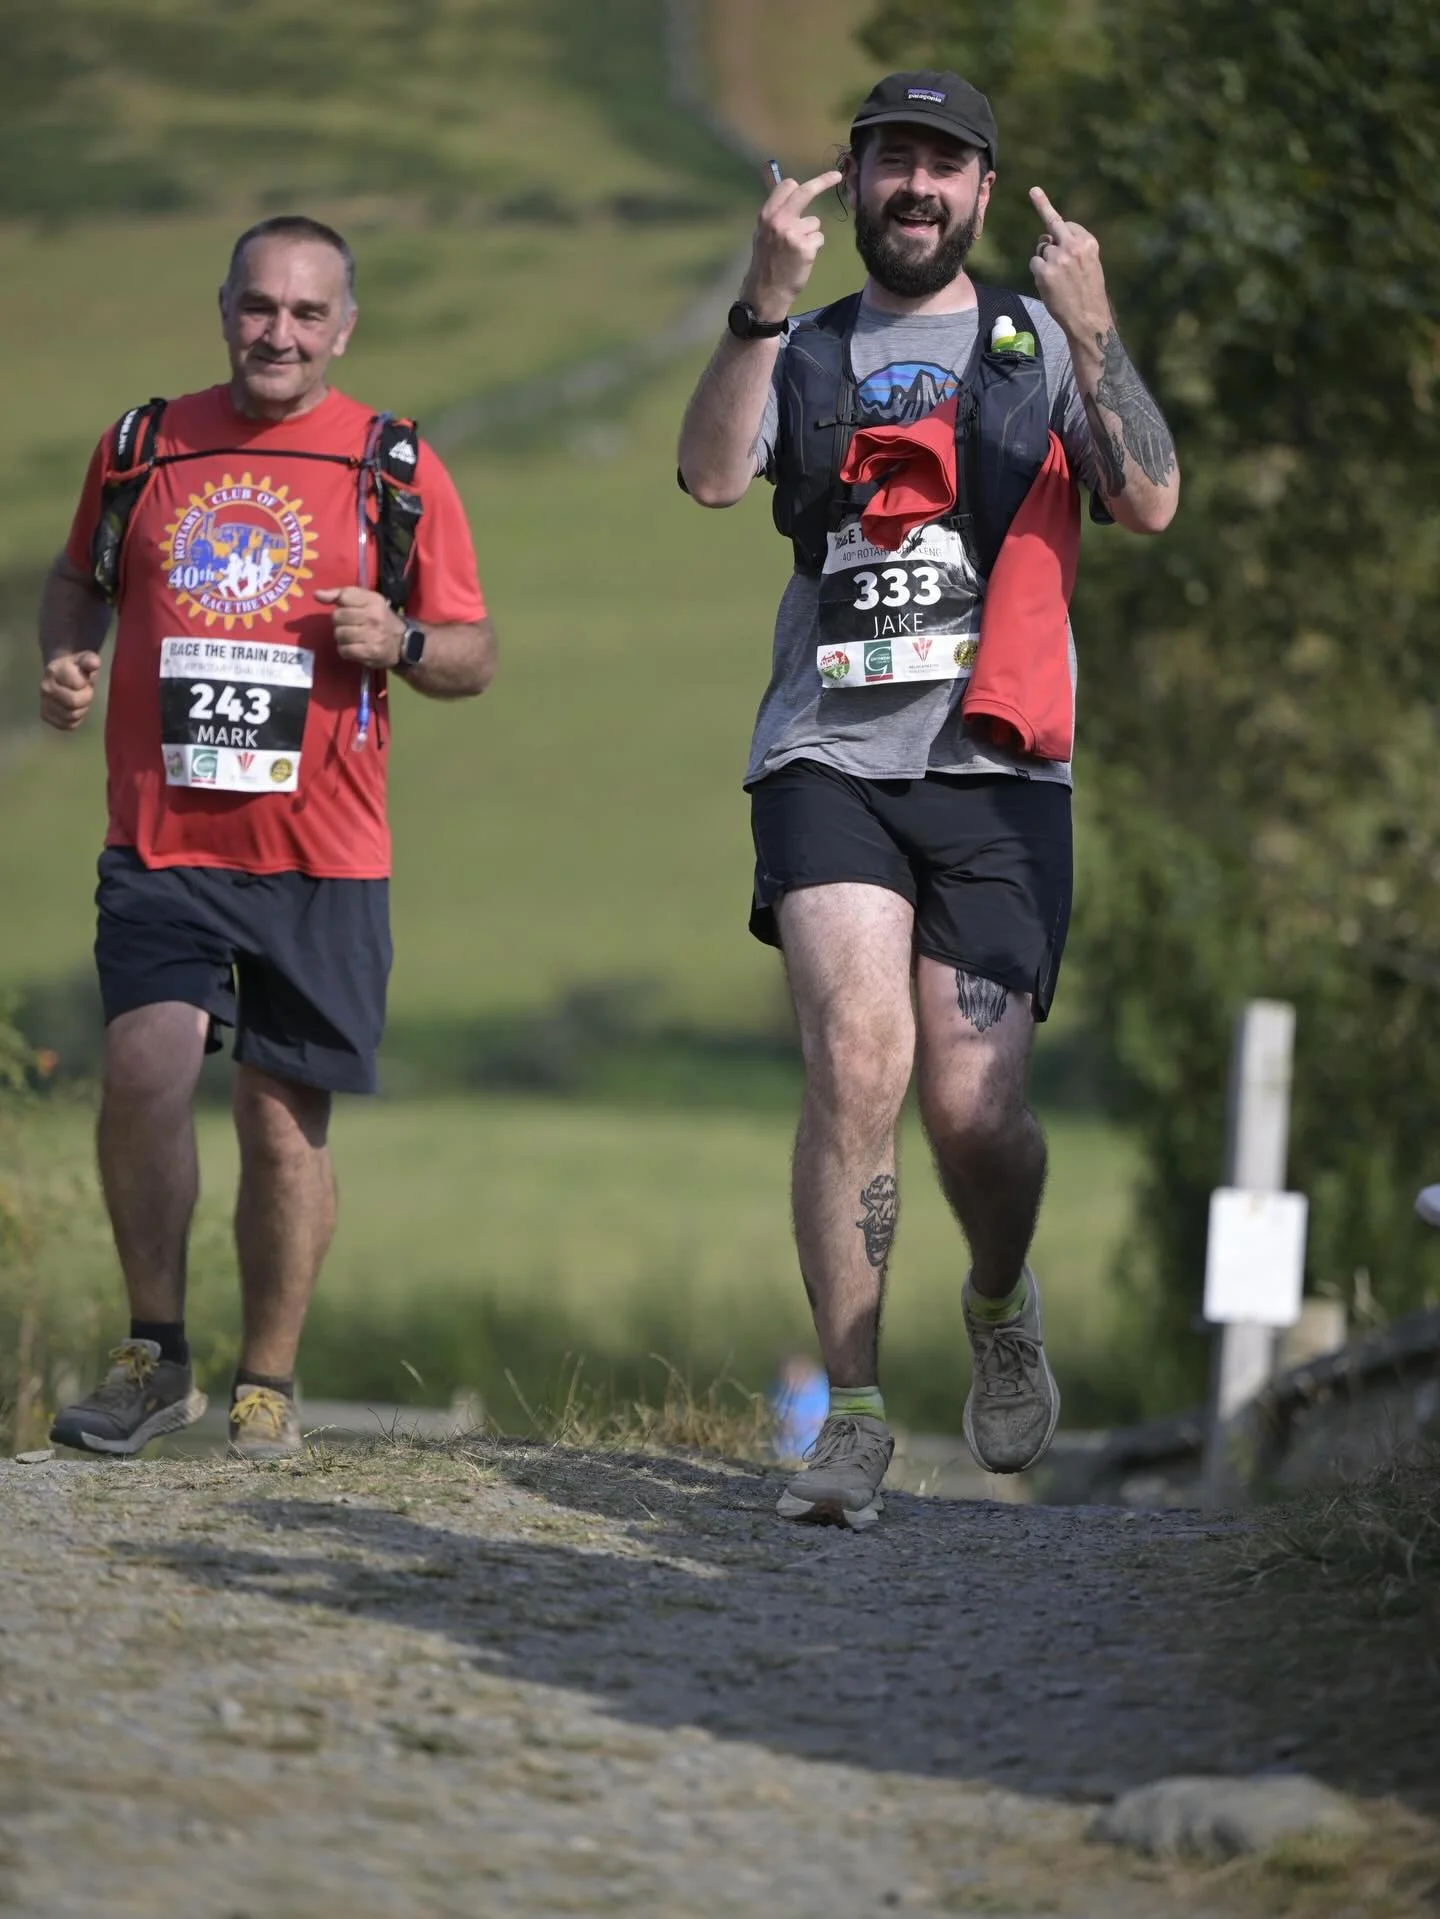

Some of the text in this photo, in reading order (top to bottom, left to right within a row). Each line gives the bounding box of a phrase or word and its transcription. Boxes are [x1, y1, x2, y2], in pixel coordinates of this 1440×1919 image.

[907, 93, 942, 103] patagonia
[174, 488, 302, 567] ROTARY CLUB OF TYWYN
[168, 564, 215, 588] 40th
[852, 566, 942, 611] 333
[200, 574, 292, 614] RACE THE TRAIN
[873, 612, 925, 639] JAKE
[169, 642, 200, 657] RACE
[205, 644, 226, 658] THE
[231, 646, 269, 662] TRAIN
[188, 683, 272, 725] 243
[196, 725, 260, 748] MARK
